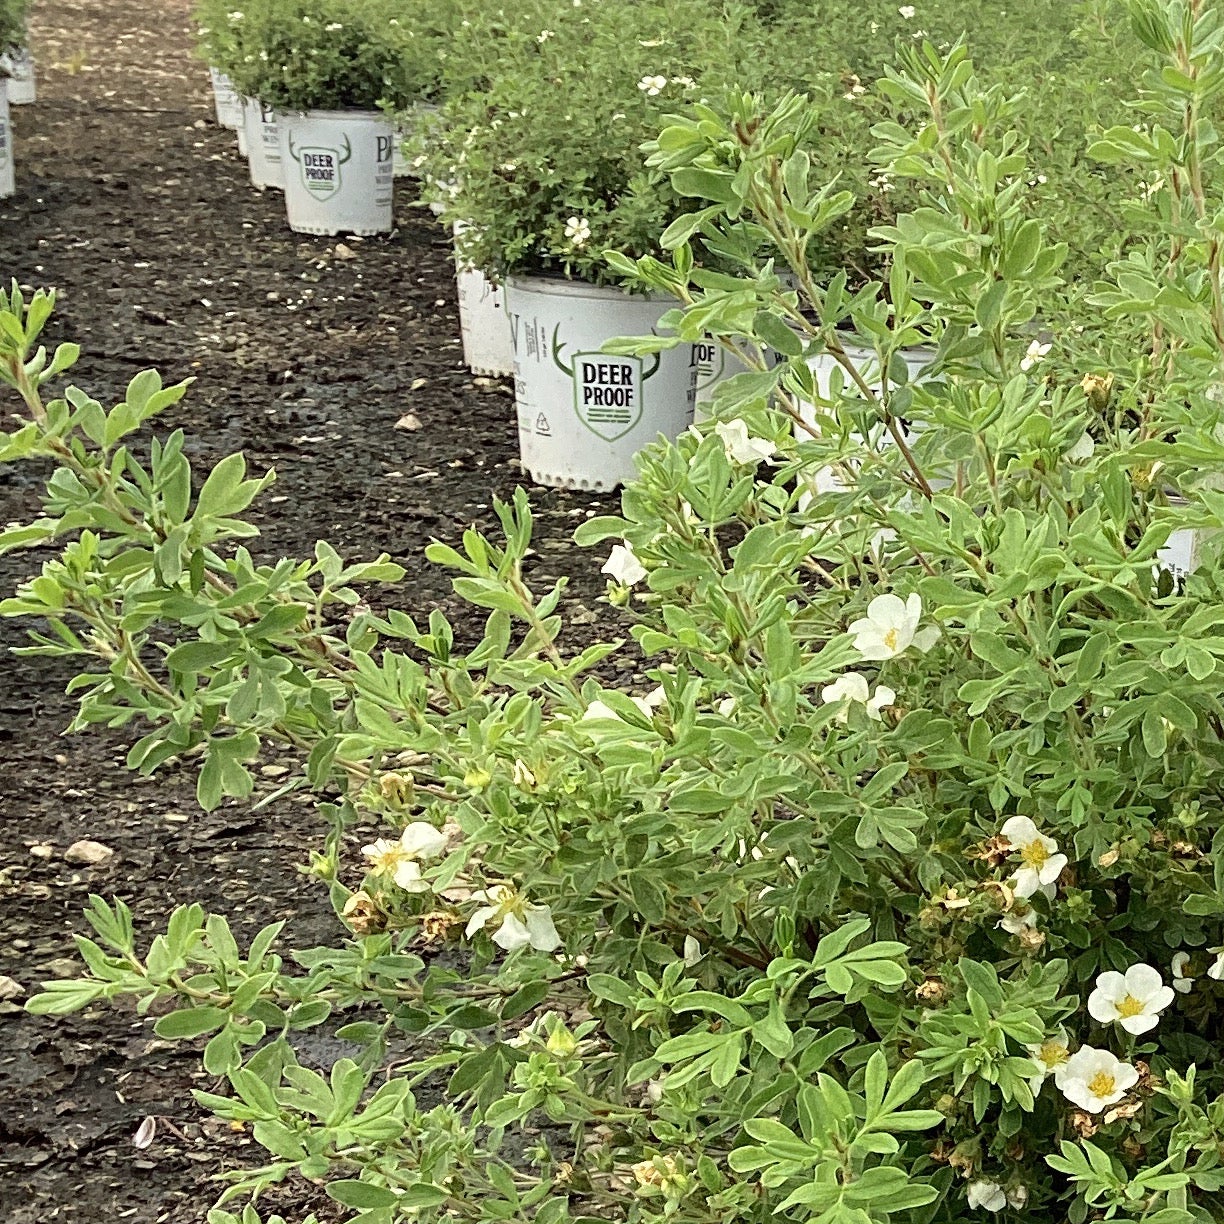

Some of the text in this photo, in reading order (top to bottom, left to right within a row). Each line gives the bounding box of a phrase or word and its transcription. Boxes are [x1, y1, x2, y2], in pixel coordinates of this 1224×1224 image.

[304, 153, 333, 168] DEER
[305, 168, 334, 181] PROOF
[581, 362, 633, 385] DEER
[583, 386, 634, 407] PROOF
